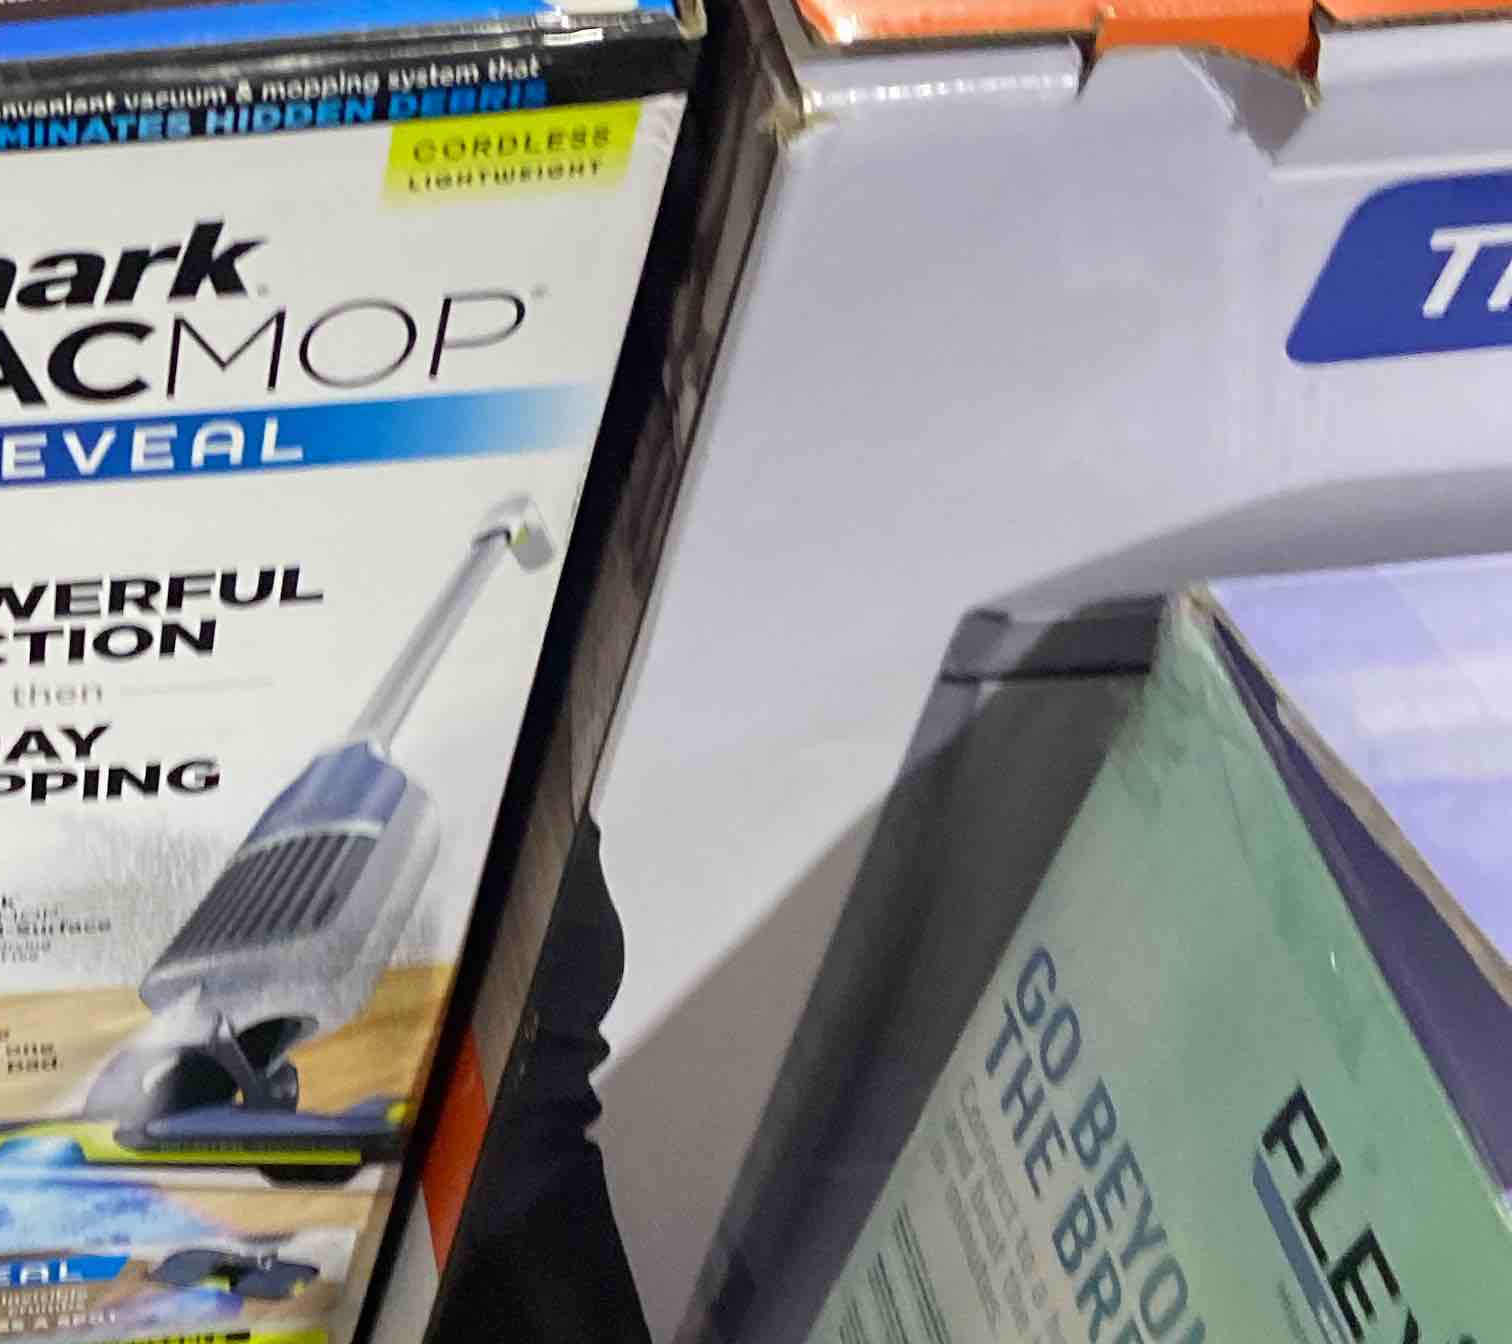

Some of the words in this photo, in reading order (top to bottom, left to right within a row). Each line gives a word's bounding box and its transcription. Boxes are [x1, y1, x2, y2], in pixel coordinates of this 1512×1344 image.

[388, 60, 481, 94] system
[489, 53, 541, 81] that
[204, 95, 377, 138] HIDDEN
[412, 124, 612, 164] CORDLESS
[408, 159, 605, 193] LIGHTWEIGHT
[13, 679, 105, 710] then
[1014, 944, 1083, 1085] GO
[984, 997, 1067, 1199] THE
